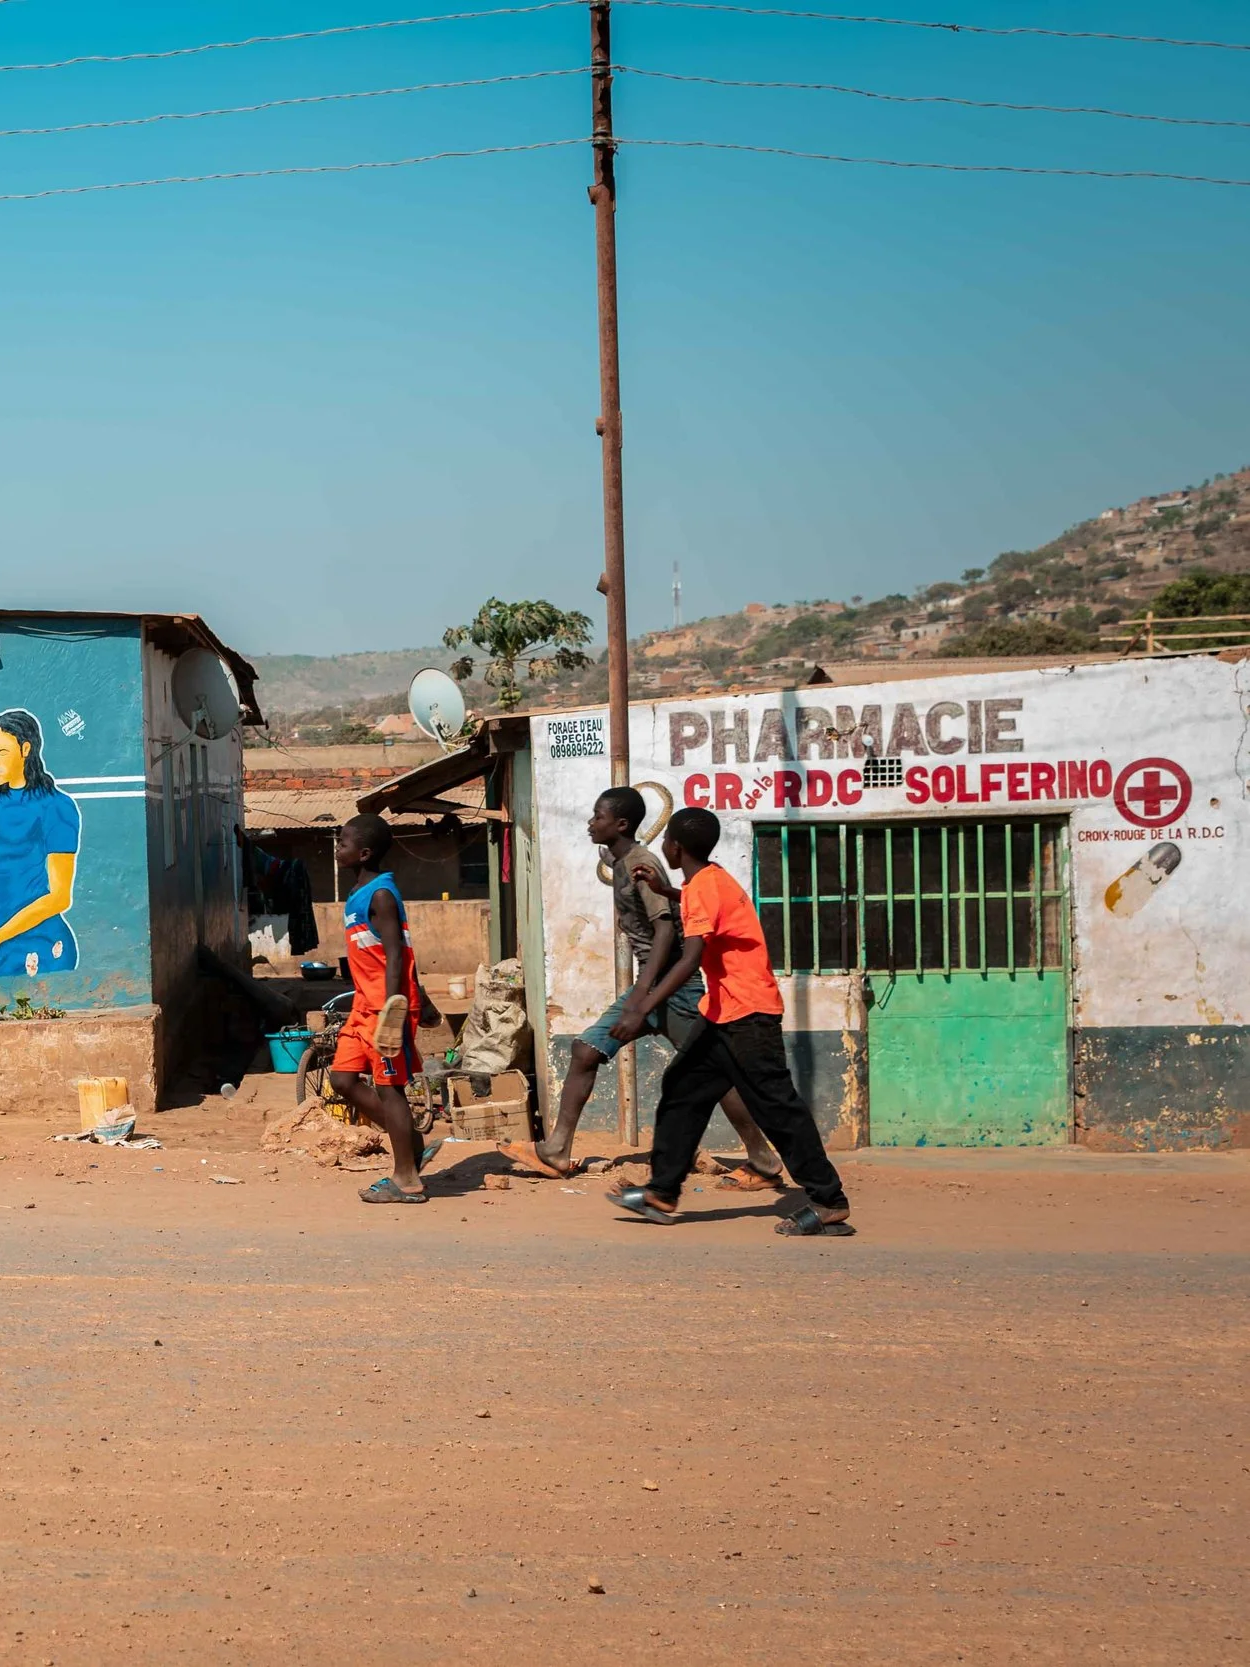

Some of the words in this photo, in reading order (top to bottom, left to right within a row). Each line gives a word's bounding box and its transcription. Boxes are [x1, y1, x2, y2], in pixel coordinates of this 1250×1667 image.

[548, 720, 578, 735] FORAGE
[580, 718, 602, 733] D'EAU
[669, 697, 1025, 767] PHARMACIE
[555, 732, 600, 745] SPECIAL
[550, 741, 604, 758] 0898896222
[904, 759, 1113, 805] SOLFERINO
[1078, 829, 1146, 843] CROIX-ROUGE
[1150, 828, 1163, 840] DE
[1168, 827, 1183, 840] LA
[381, 1056, 398, 1076] 1
